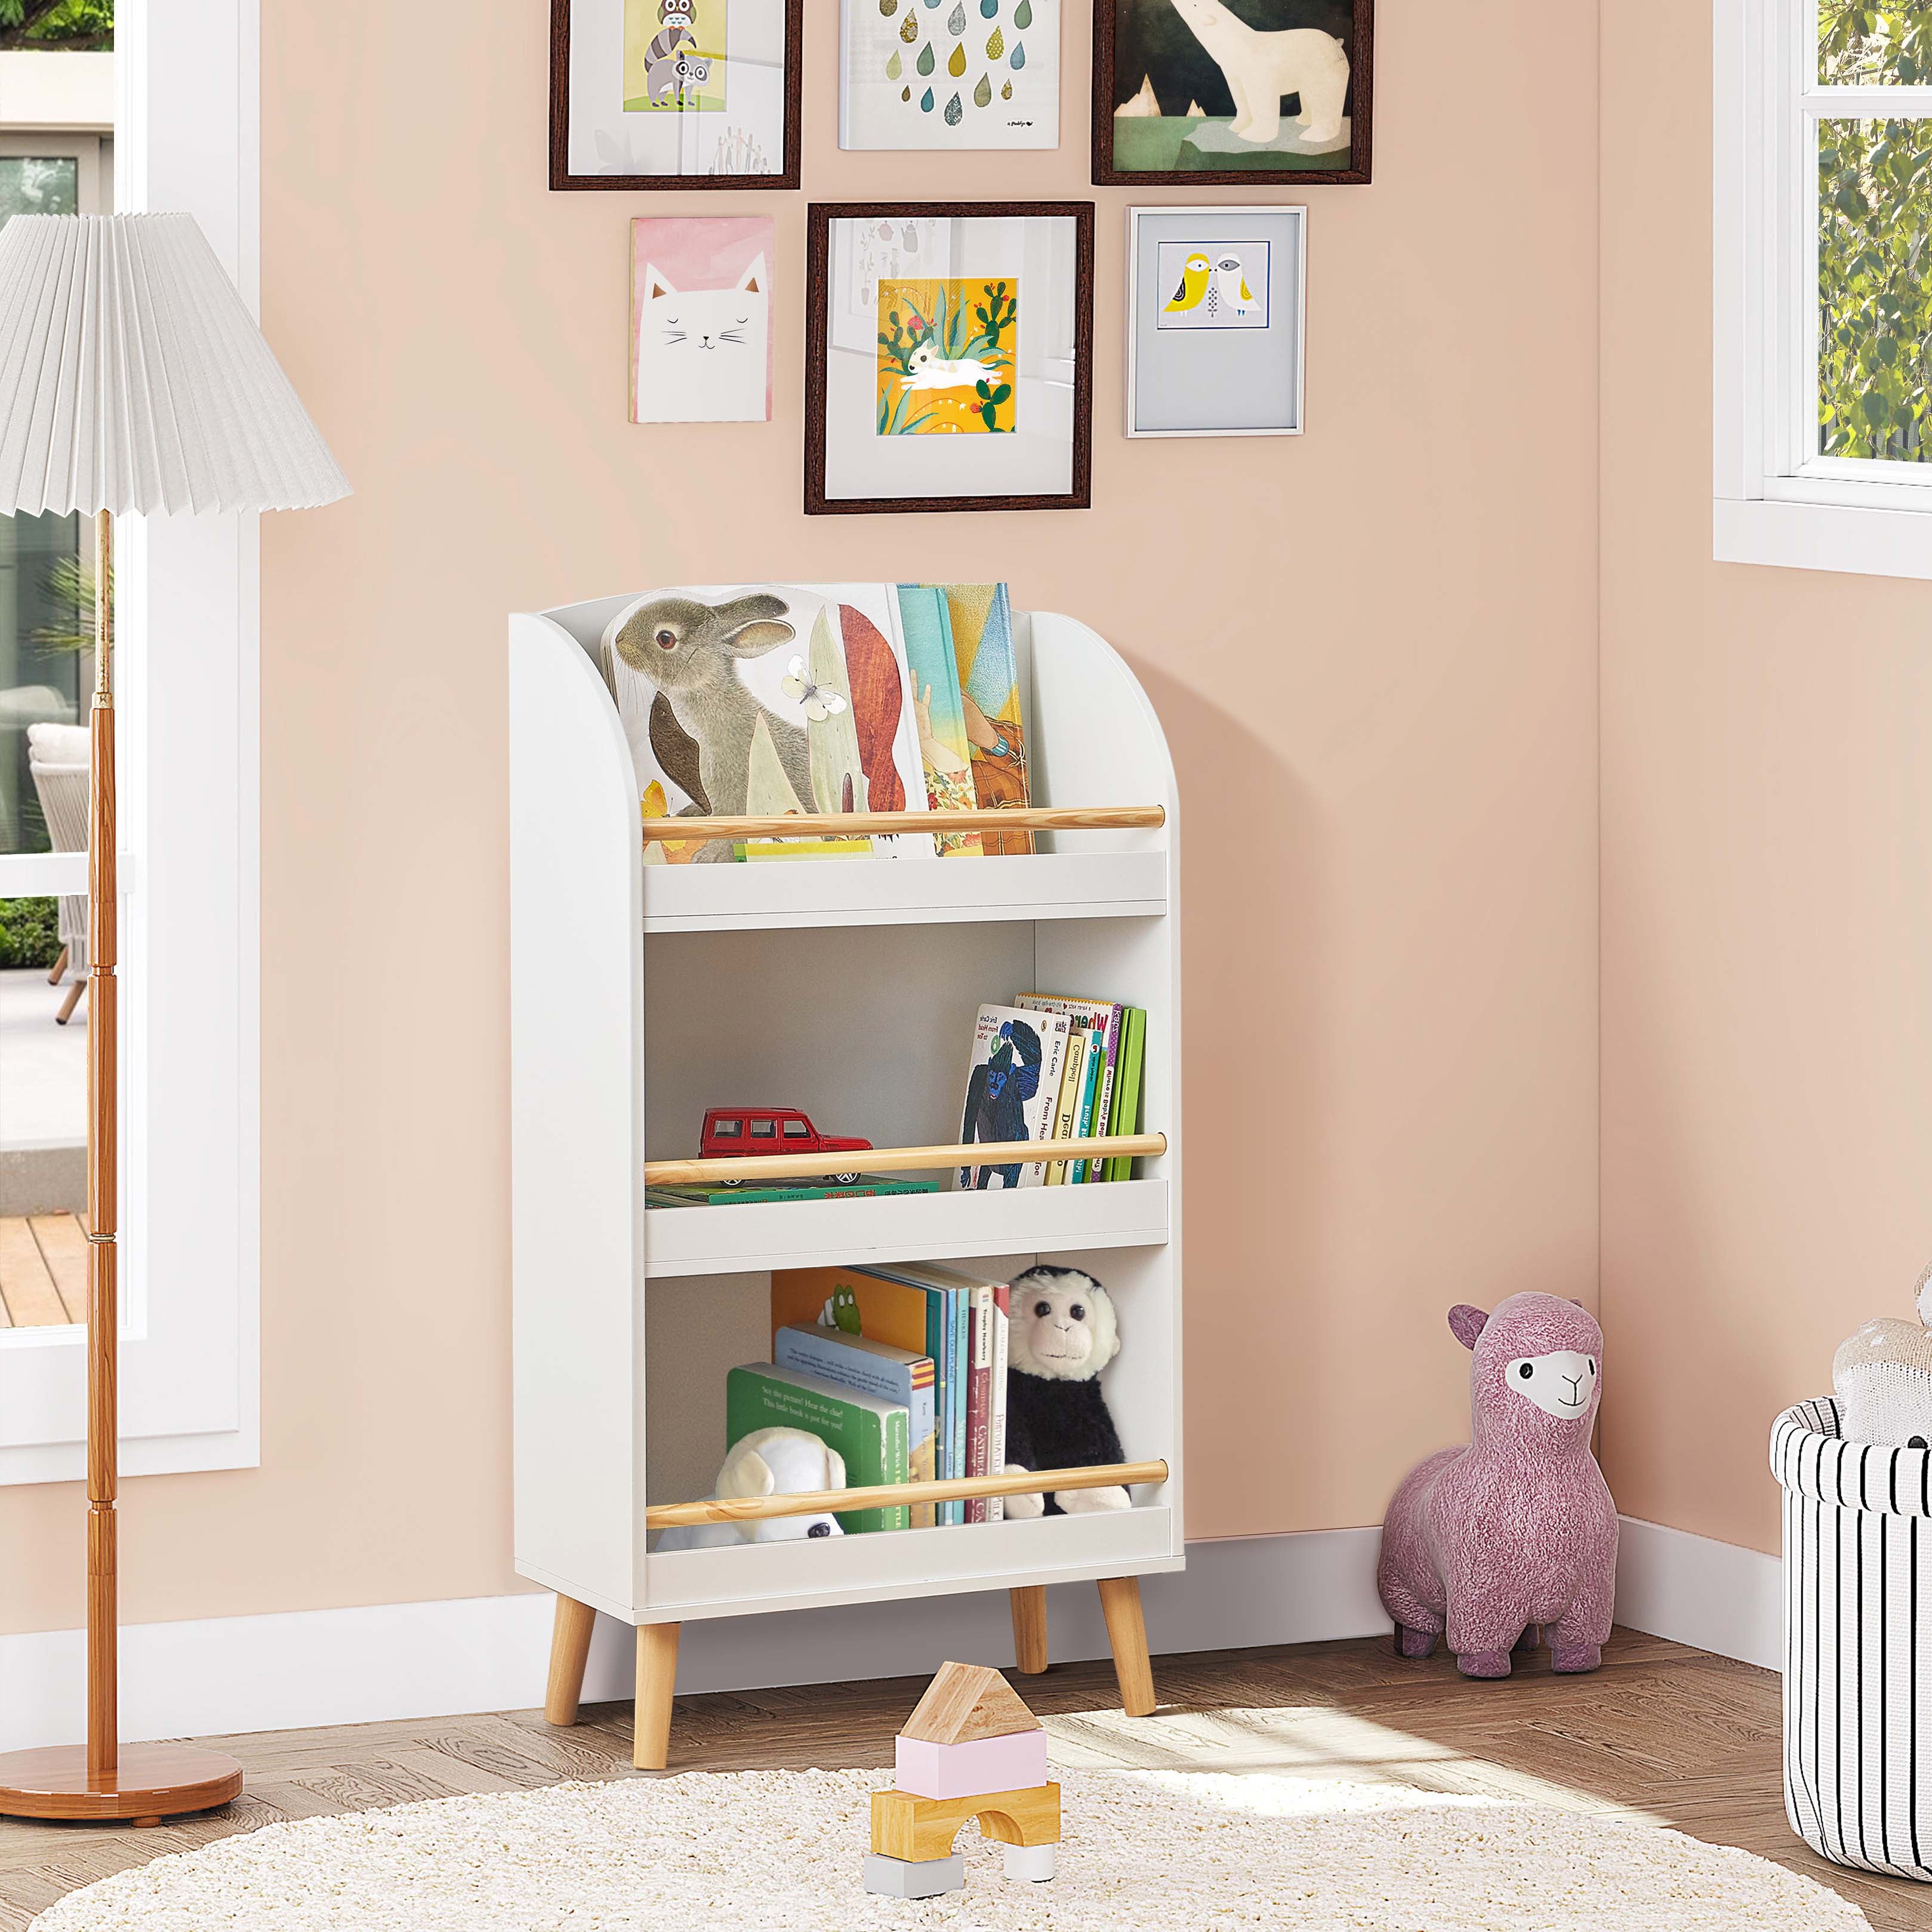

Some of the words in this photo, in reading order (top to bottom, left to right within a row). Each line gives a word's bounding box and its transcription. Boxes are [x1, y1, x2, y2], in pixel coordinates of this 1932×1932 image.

[1049, 1057, 1058, 1077] Carle
[1042, 1096, 1052, 1120] From
[1039, 1123, 1048, 1141] Hea
